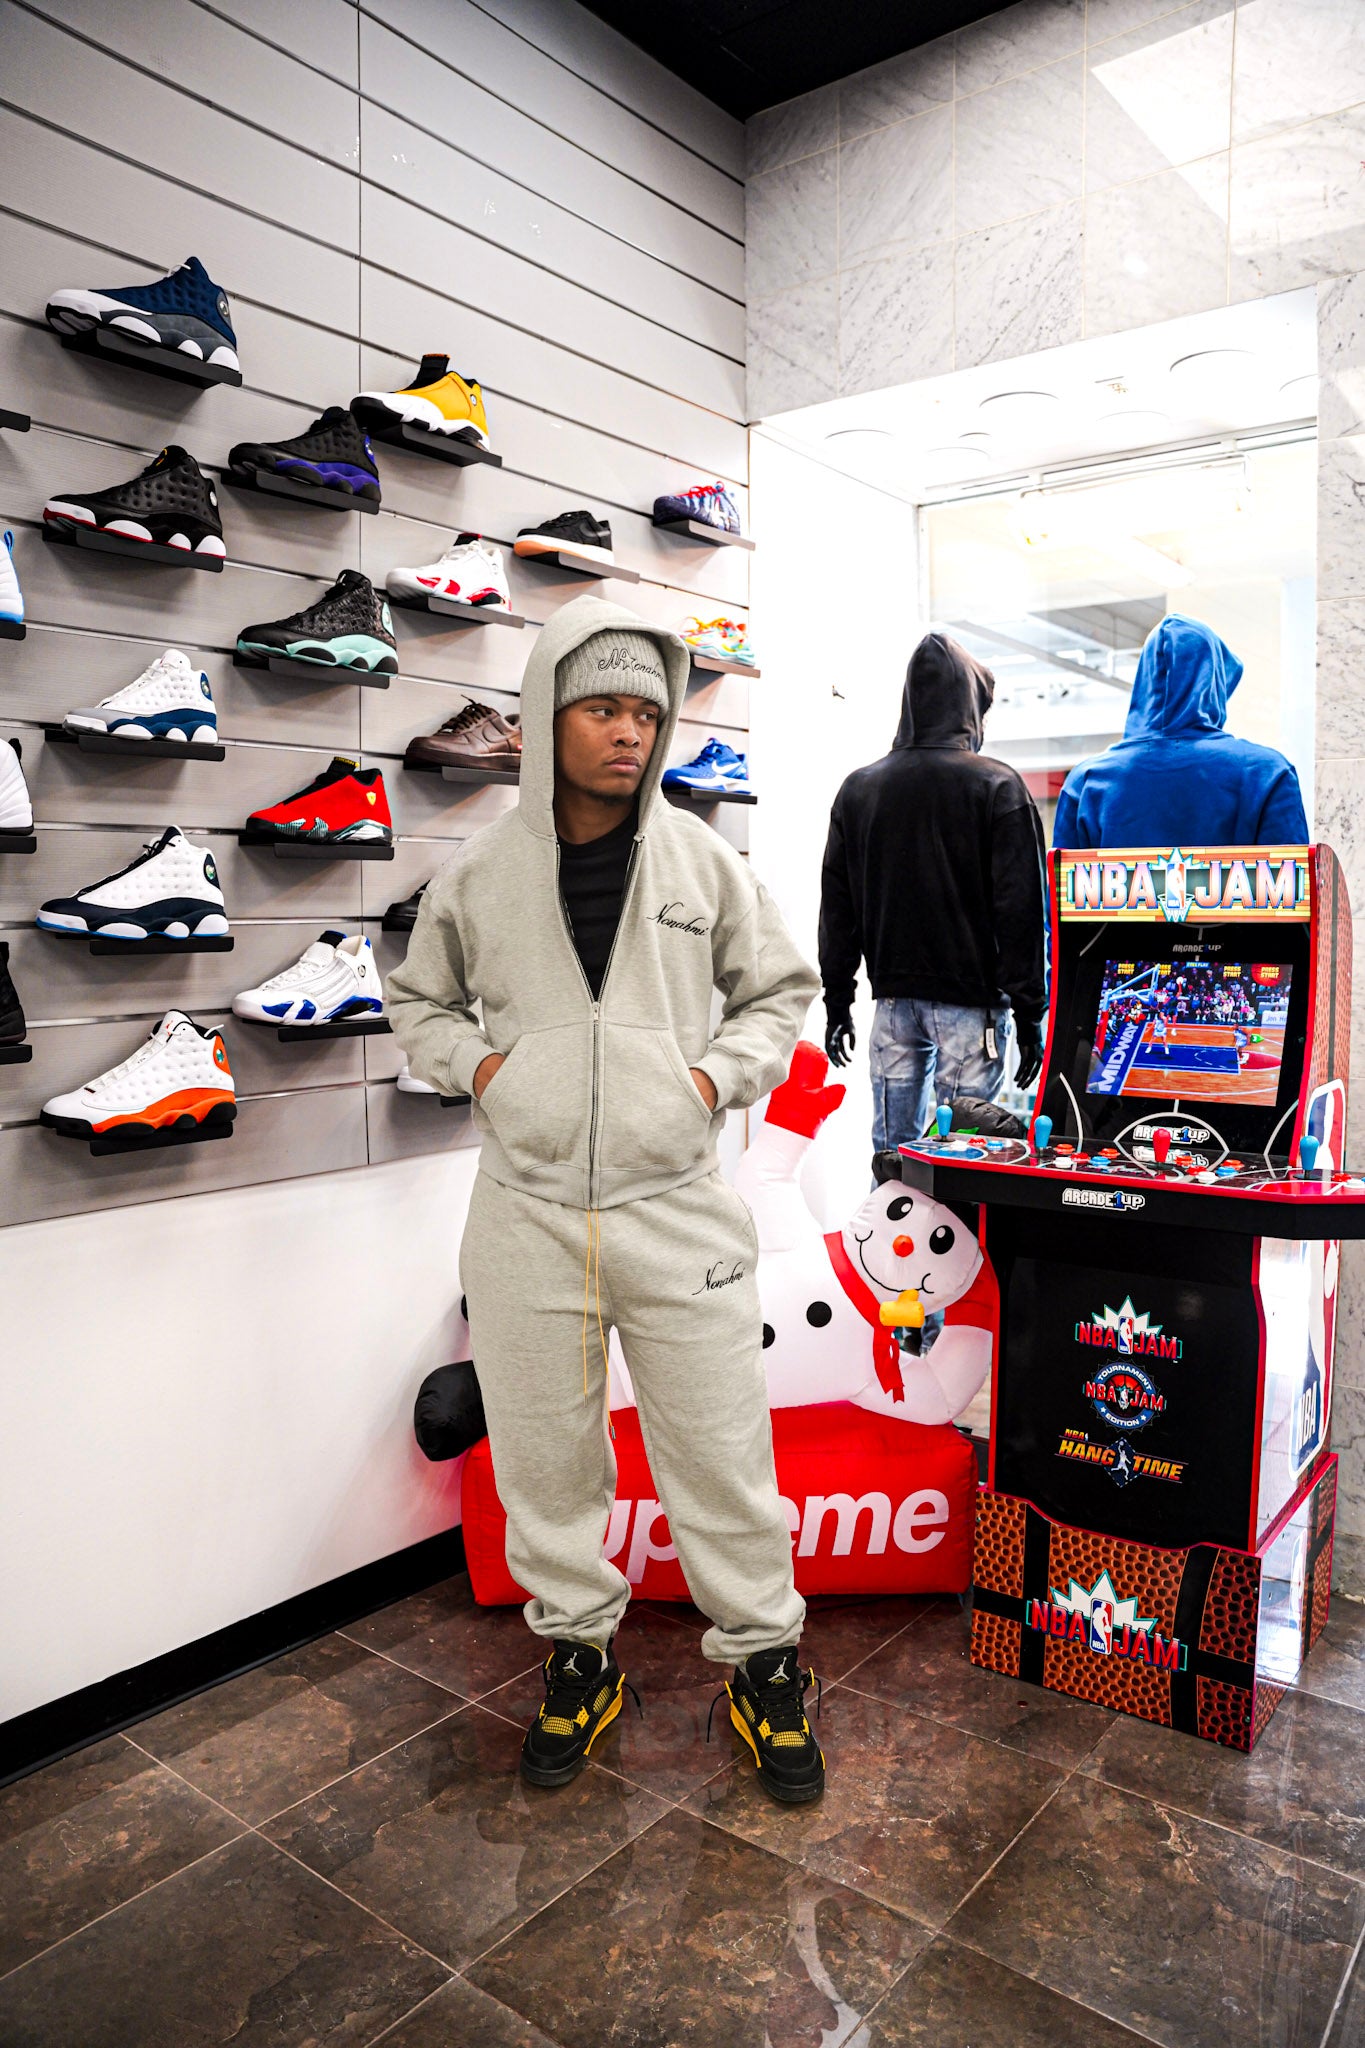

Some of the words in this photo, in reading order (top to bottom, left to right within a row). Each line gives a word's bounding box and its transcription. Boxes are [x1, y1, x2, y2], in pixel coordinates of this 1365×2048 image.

[1074, 862, 1159, 909] NBA
[1194, 860, 1296, 909] JAM
[1098, 1021, 1139, 1092] MIDWAY
[1078, 1321, 1117, 1350] NBA
[1133, 1331, 1178, 1360] JAM
[1098, 1365, 1152, 1391] TOURNAMENT
[1085, 1381, 1116, 1403] NBA
[1129, 1390, 1164, 1412] JAM
[1063, 1428, 1085, 1440] NBA
[1105, 1413, 1140, 1427] EDITION
[1058, 1439, 1116, 1466] HANG
[1132, 1454, 1184, 1481] TIME
[1031, 1598, 1087, 1645] NBA
[1113, 1622, 1182, 1673] JAM
[1091, 1639, 1106, 1652] NBA
